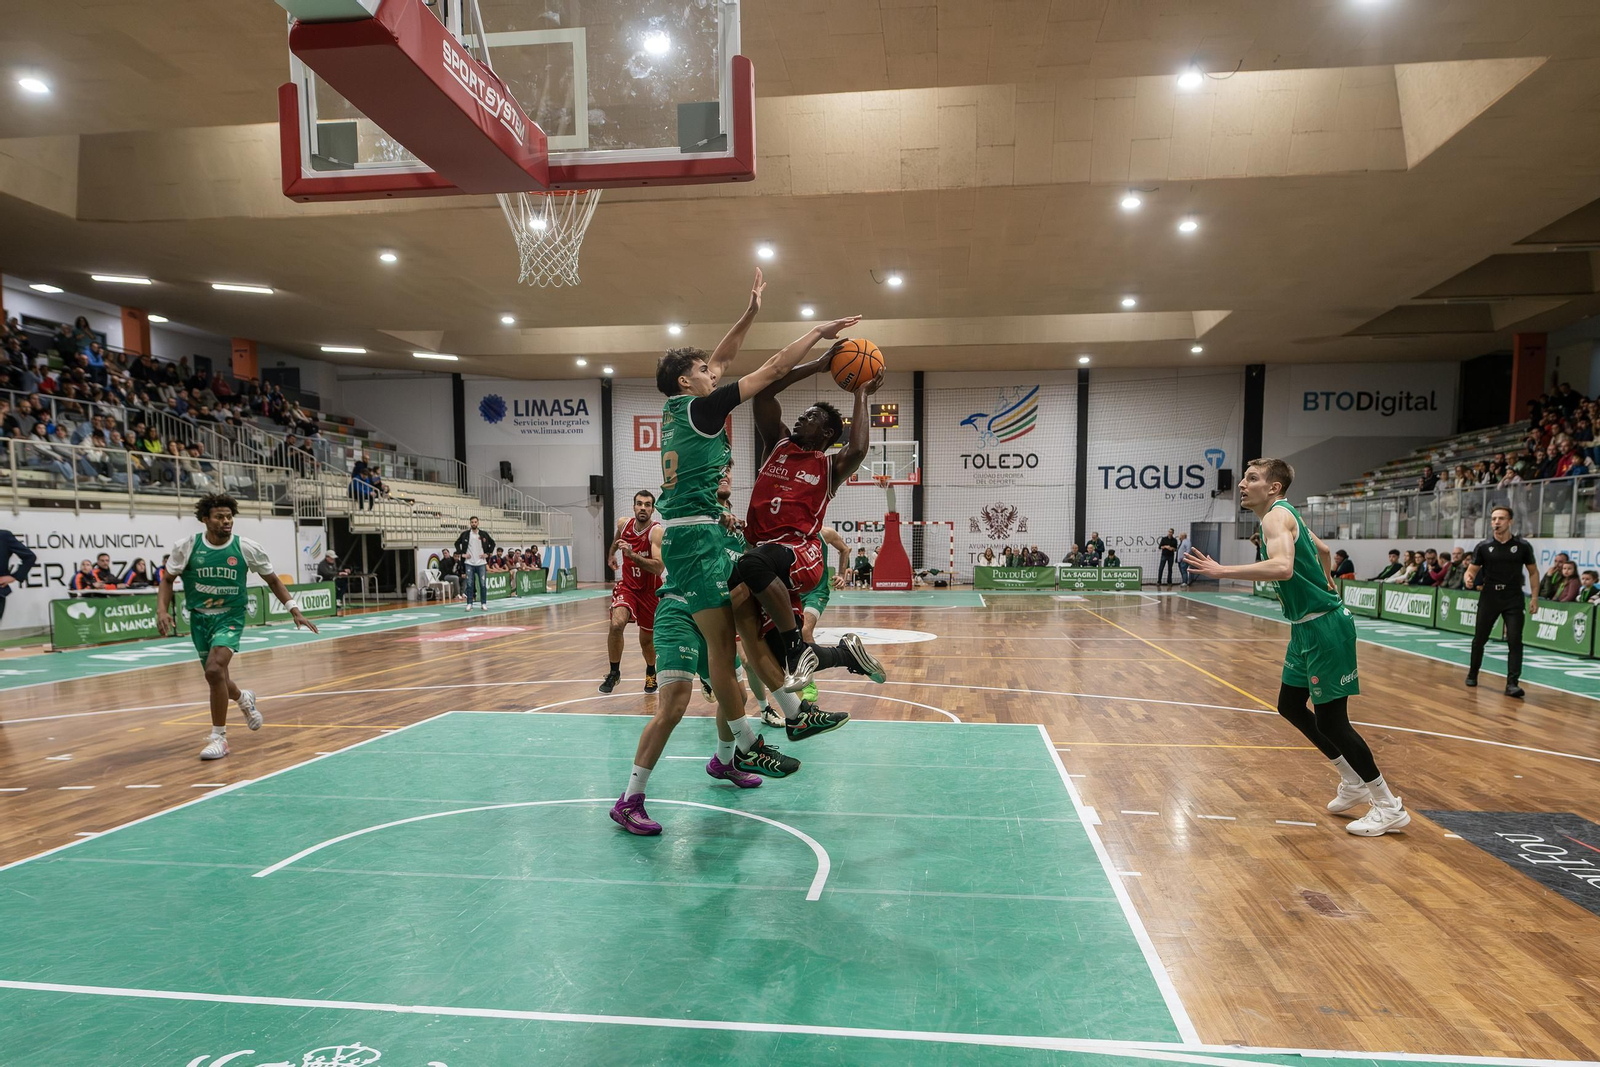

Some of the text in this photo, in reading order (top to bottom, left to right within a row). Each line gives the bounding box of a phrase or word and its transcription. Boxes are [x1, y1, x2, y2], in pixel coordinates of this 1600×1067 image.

[513, 398, 590, 417] LIMASA
[1303, 391, 1438, 417] BTODigital
[513, 418, 590, 428] Servicios Integrales
[960, 453, 1039, 469] TOLEDO
[1180, 491, 1205, 500] facsa
[770, 497, 782, 515] 9
[832, 520, 885, 533] TOLED
[79, 534, 164, 549] MUNICIPAL
[196, 567, 237, 580] TOLEDO
[631, 567, 641, 577] 13
[104, 604, 153, 618] CASTILLA-
[105, 622, 117, 634] LA
[120, 617, 157, 632] MANCH
